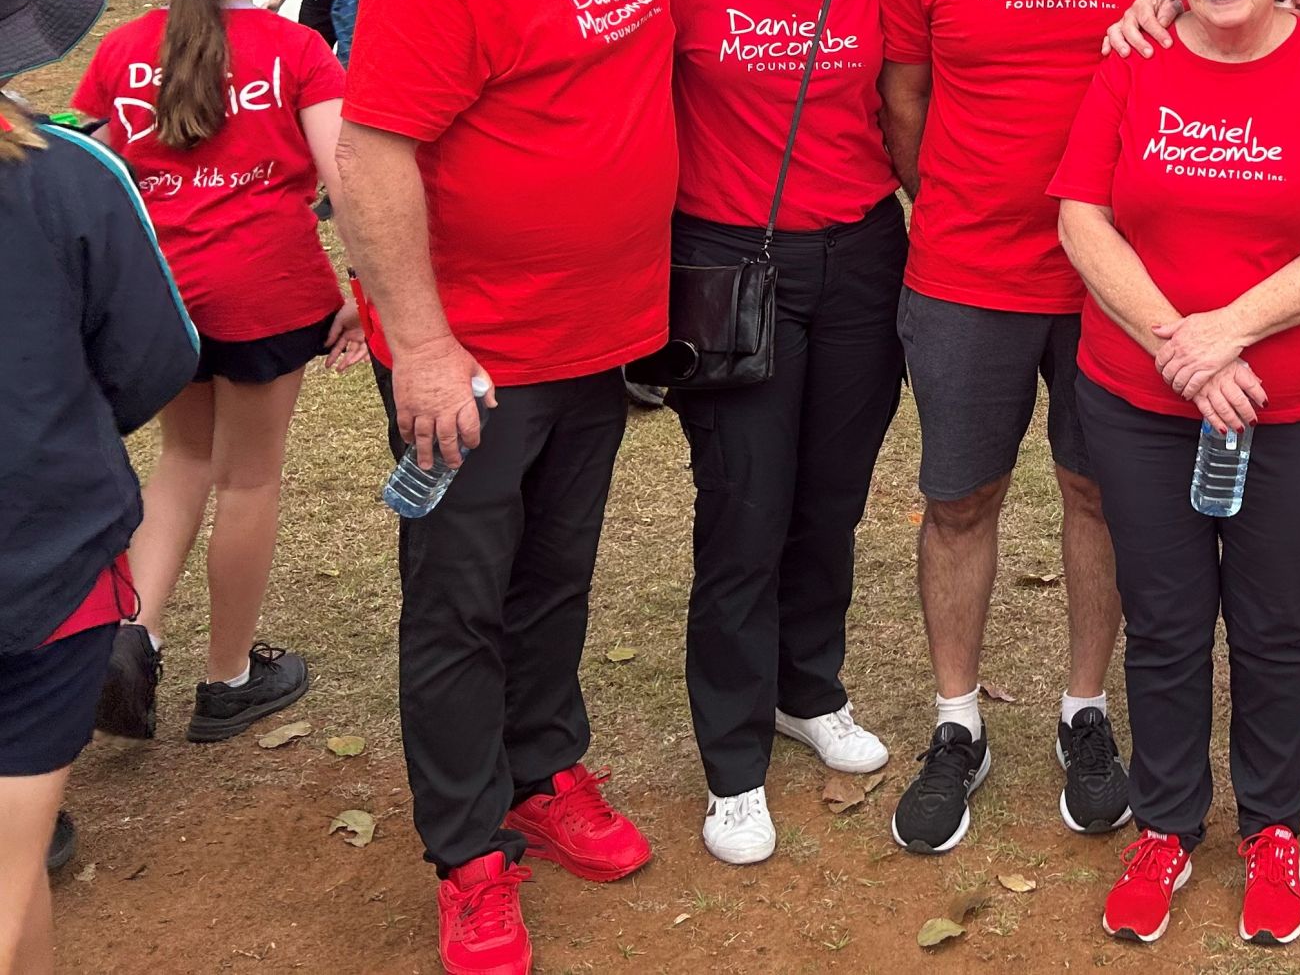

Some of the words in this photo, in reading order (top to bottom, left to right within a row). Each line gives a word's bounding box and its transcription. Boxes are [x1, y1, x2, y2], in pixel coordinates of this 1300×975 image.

[1006, 0, 1098, 9] FOUNDATION
[1102, 1, 1119, 9] Inc.
[748, 60, 843, 72] FOUNDAION
[114, 56, 282, 144] Diel
[1158, 106, 1252, 144] Daniel
[1143, 136, 1282, 162] Morcombe
[193, 166, 225, 188] kids
[1166, 164, 1263, 181] FOUNDATION
[1268, 173, 1286, 182] Inc.
